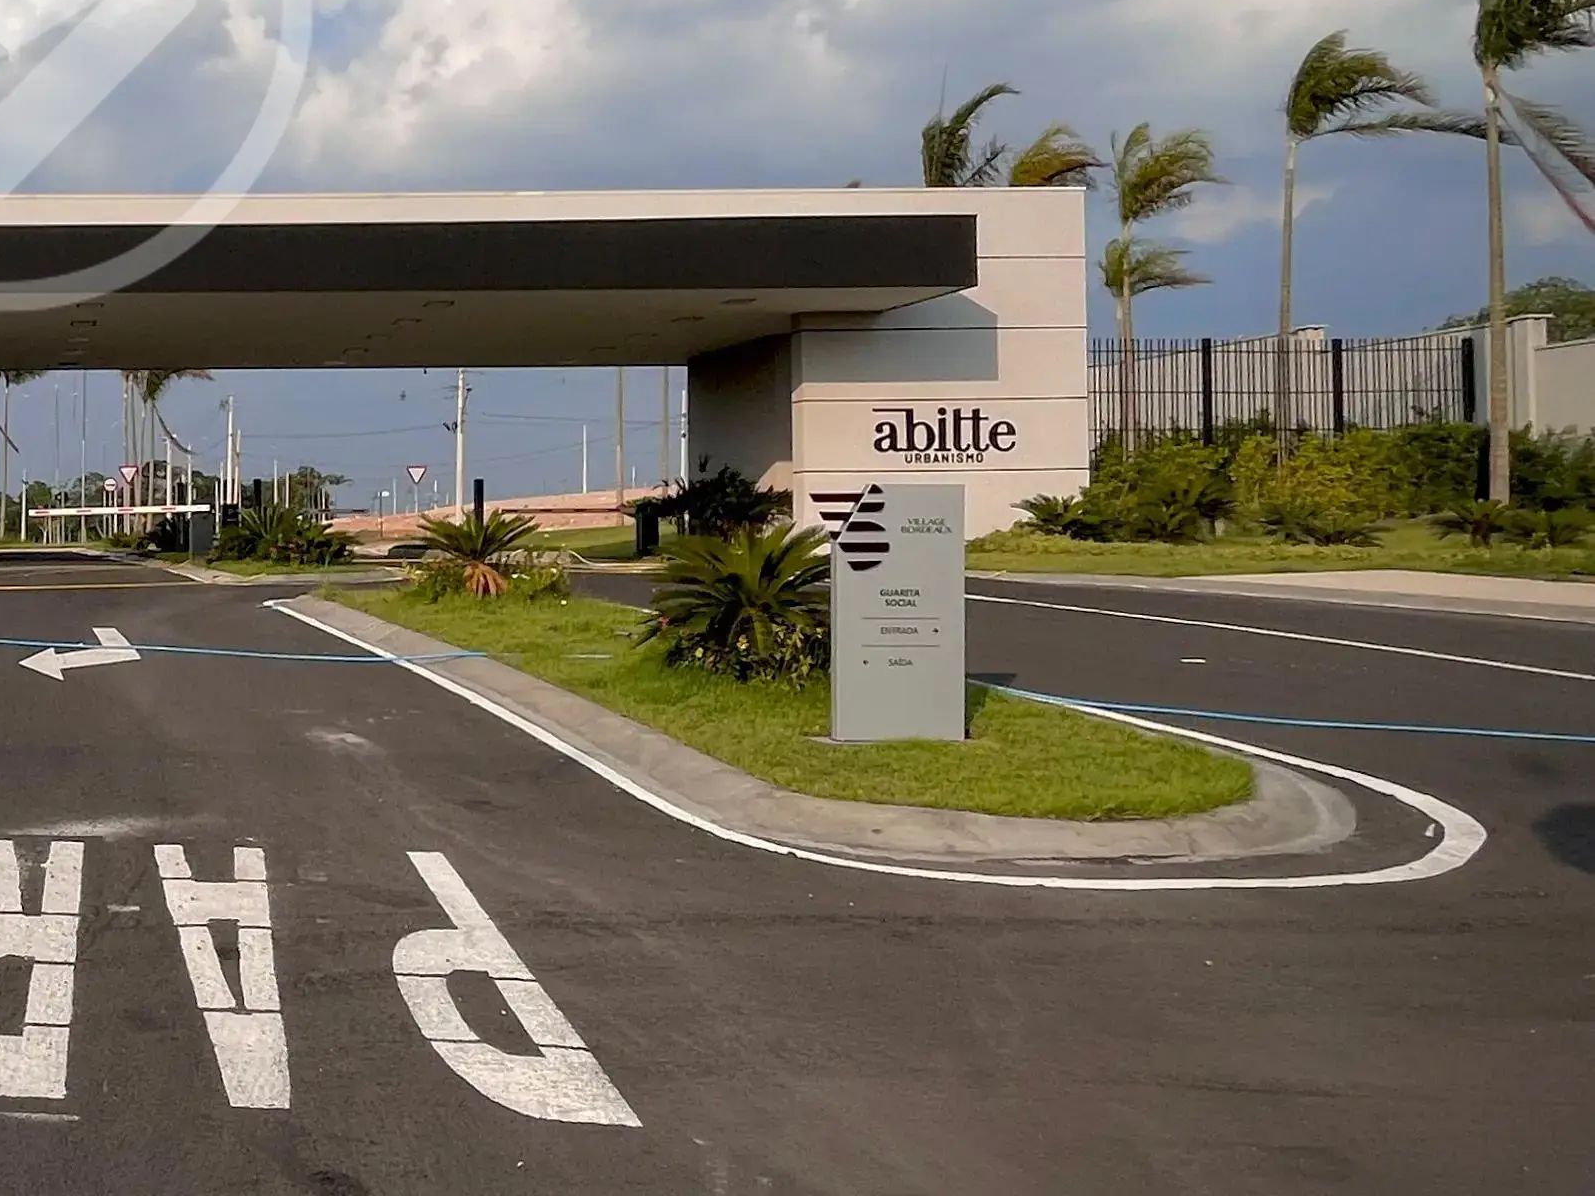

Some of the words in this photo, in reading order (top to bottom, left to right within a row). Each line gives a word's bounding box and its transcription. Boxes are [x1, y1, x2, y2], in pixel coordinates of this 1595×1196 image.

[872, 407, 1017, 452] abitte
[904, 453, 984, 464] URBANISMO
[879, 588, 921, 597] GUARITA
[884, 598, 918, 608] SOCIAL
[880, 626, 919, 635] ENTRADA
